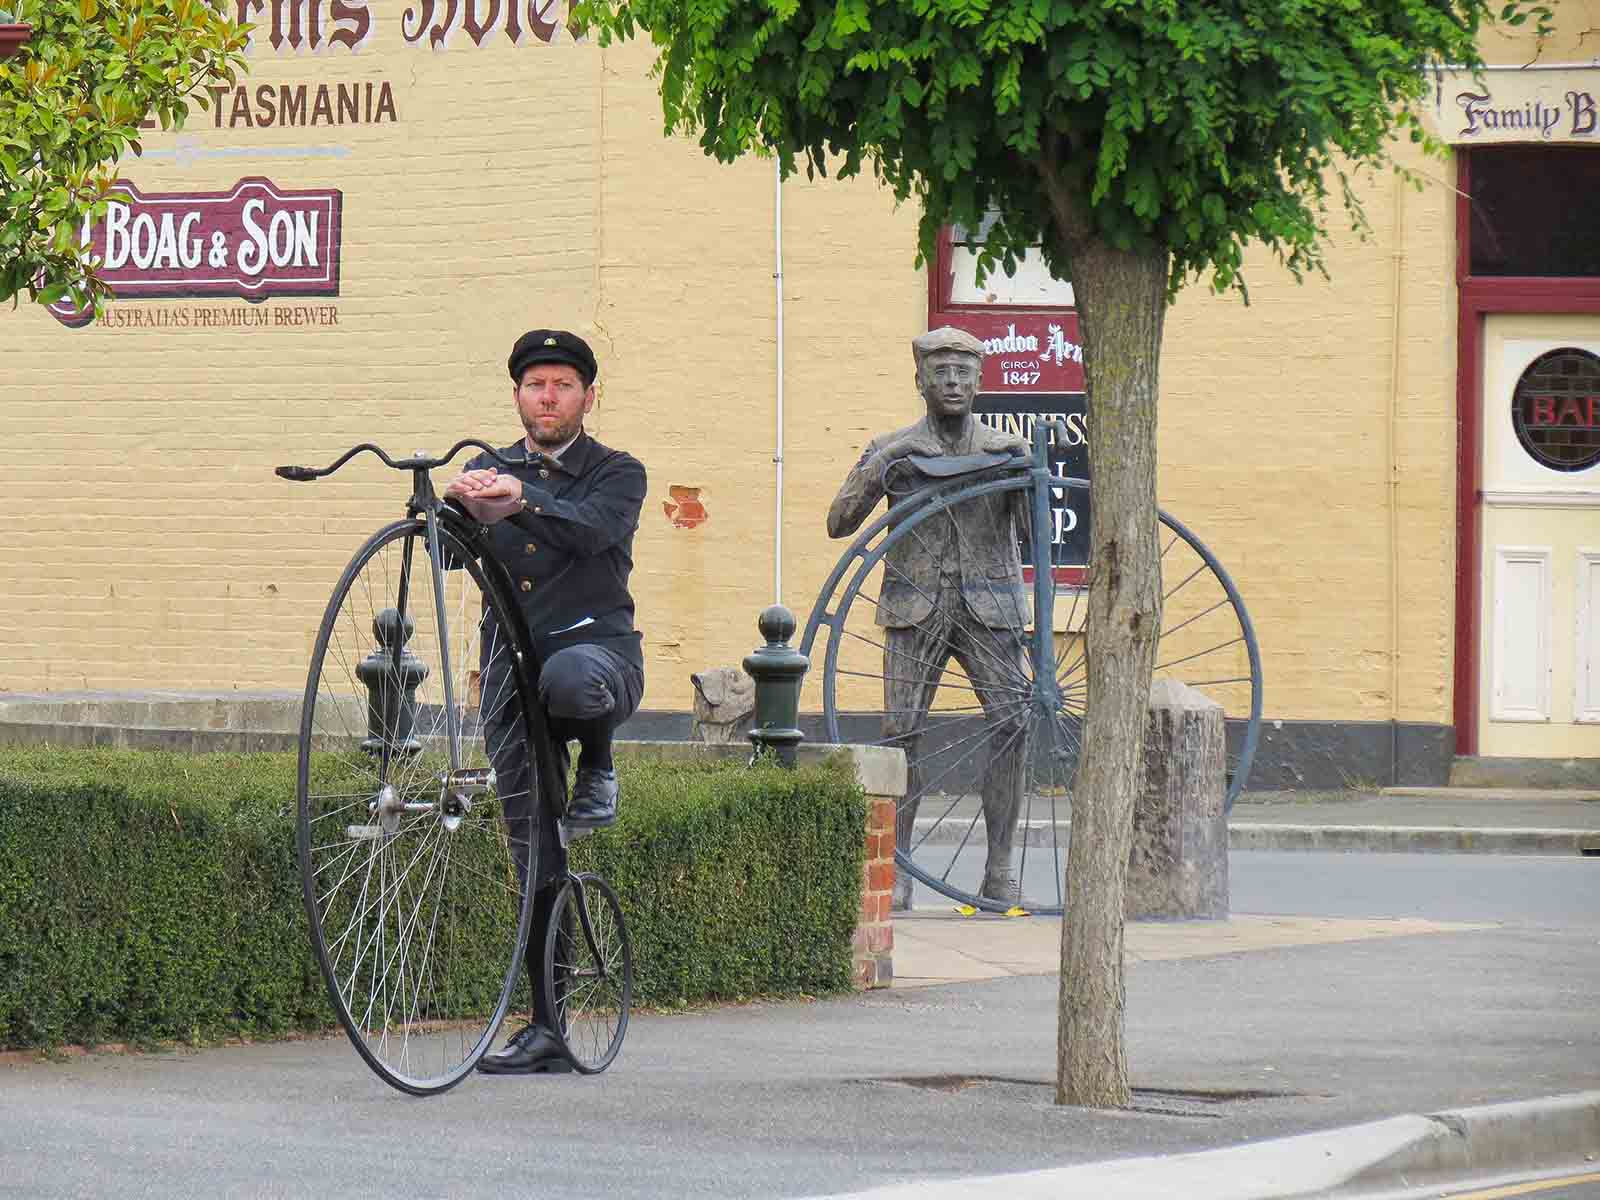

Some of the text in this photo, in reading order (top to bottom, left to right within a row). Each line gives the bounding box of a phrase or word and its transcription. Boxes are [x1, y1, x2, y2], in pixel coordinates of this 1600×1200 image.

[205, 81, 398, 129] TASMANIA
[1456, 91, 1560, 138] Family
[103, 200, 204, 271] BOAG
[207, 231, 229, 269] &
[236, 198, 319, 276] SON
[96, 306, 339, 328] AUSTRALIA'S PREMIUM BREWER
[982, 322, 1039, 355] endon
[1000, 359, 1040, 369] (CIRCA)
[1002, 371, 1041, 385] 1847
